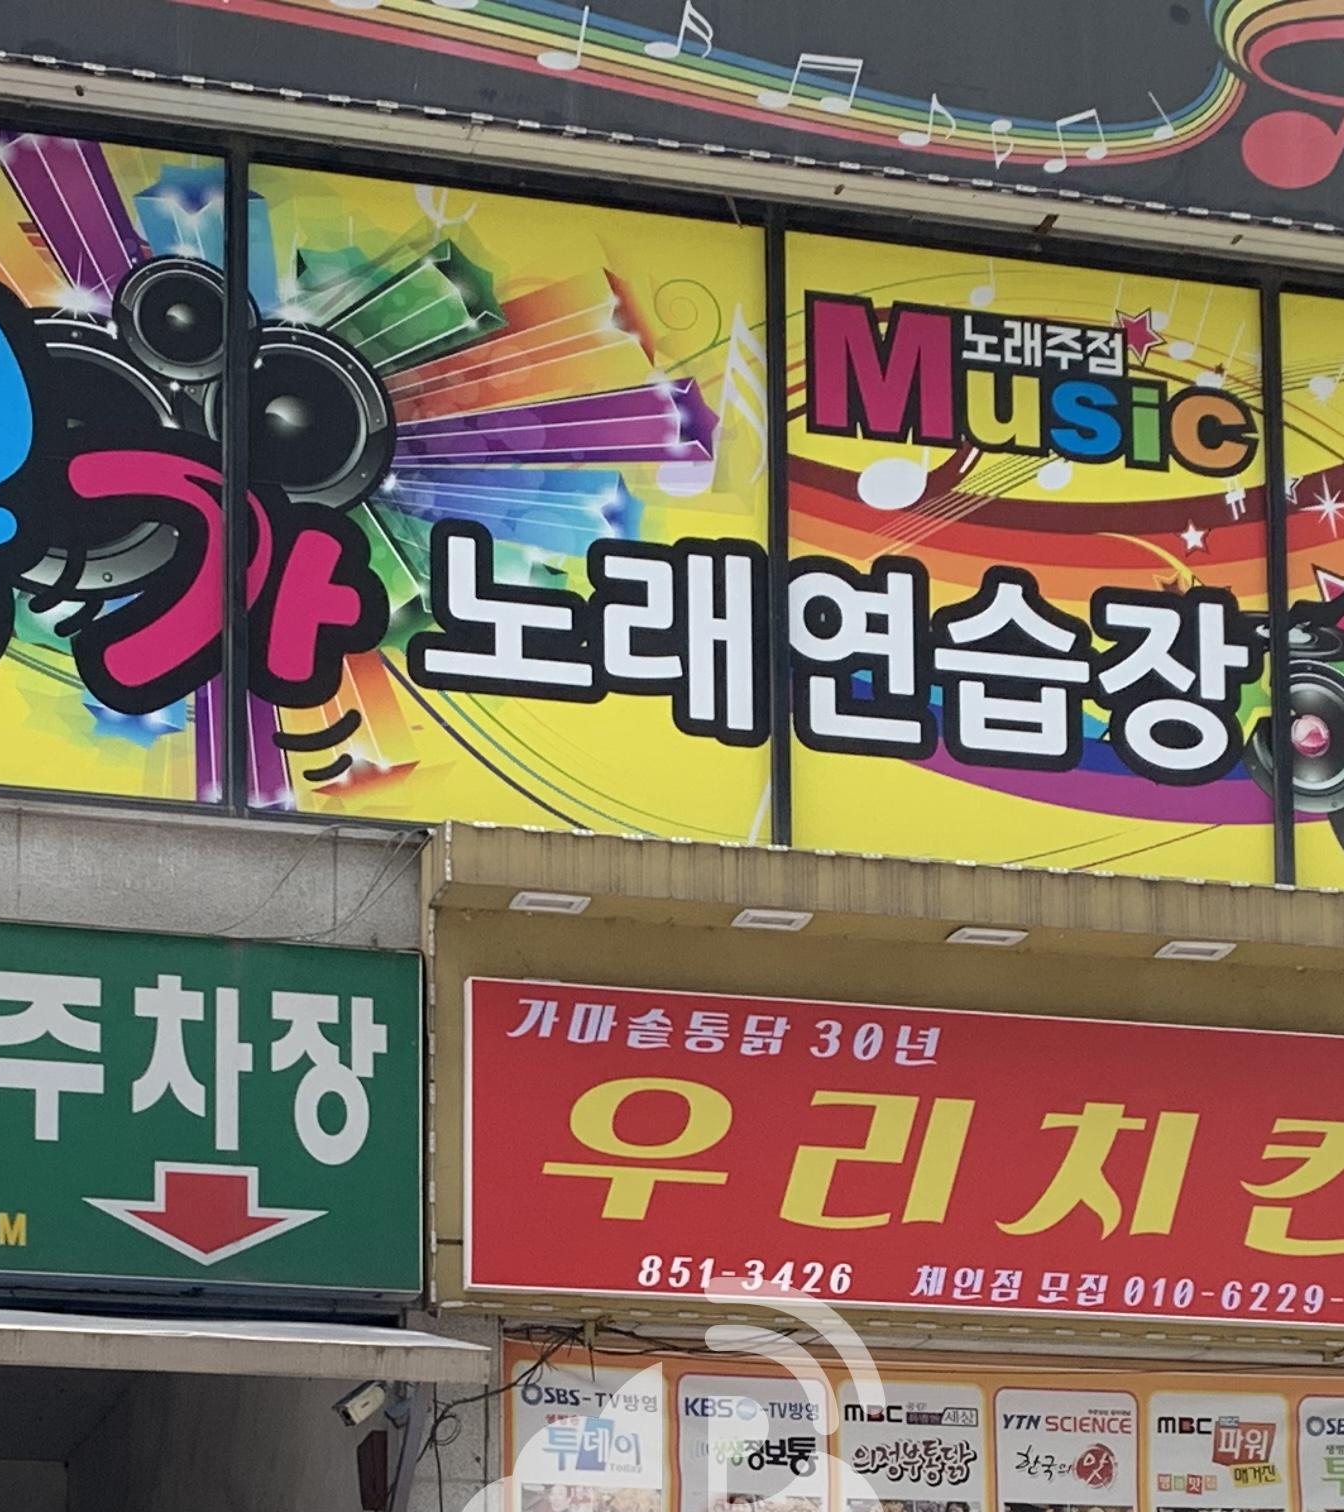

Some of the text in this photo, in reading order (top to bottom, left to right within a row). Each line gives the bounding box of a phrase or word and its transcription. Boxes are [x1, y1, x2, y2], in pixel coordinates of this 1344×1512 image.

[961, 314, 1125, 376] 노래주점
[809, 298, 1261, 474] Music
[418, 528, 1256, 776] 노래연습장
[506, 996, 941, 1067] 가마솥통닭 30년
[637, 1254, 855, 1298] 851-3426
[909, 1262, 1024, 1305] 체인점
[685, 1396, 733, 1419] KBS
[844, 1404, 904, 1423] MBC
[1002, 1414, 1133, 1434] YTN SCIENCE
[1157, 1416, 1213, 1435] MBC
[712, 1436, 819, 1479] 생생정보통
[851, 1437, 979, 1487] 의정부통닭
[1218, 1427, 1269, 1464] 파워
